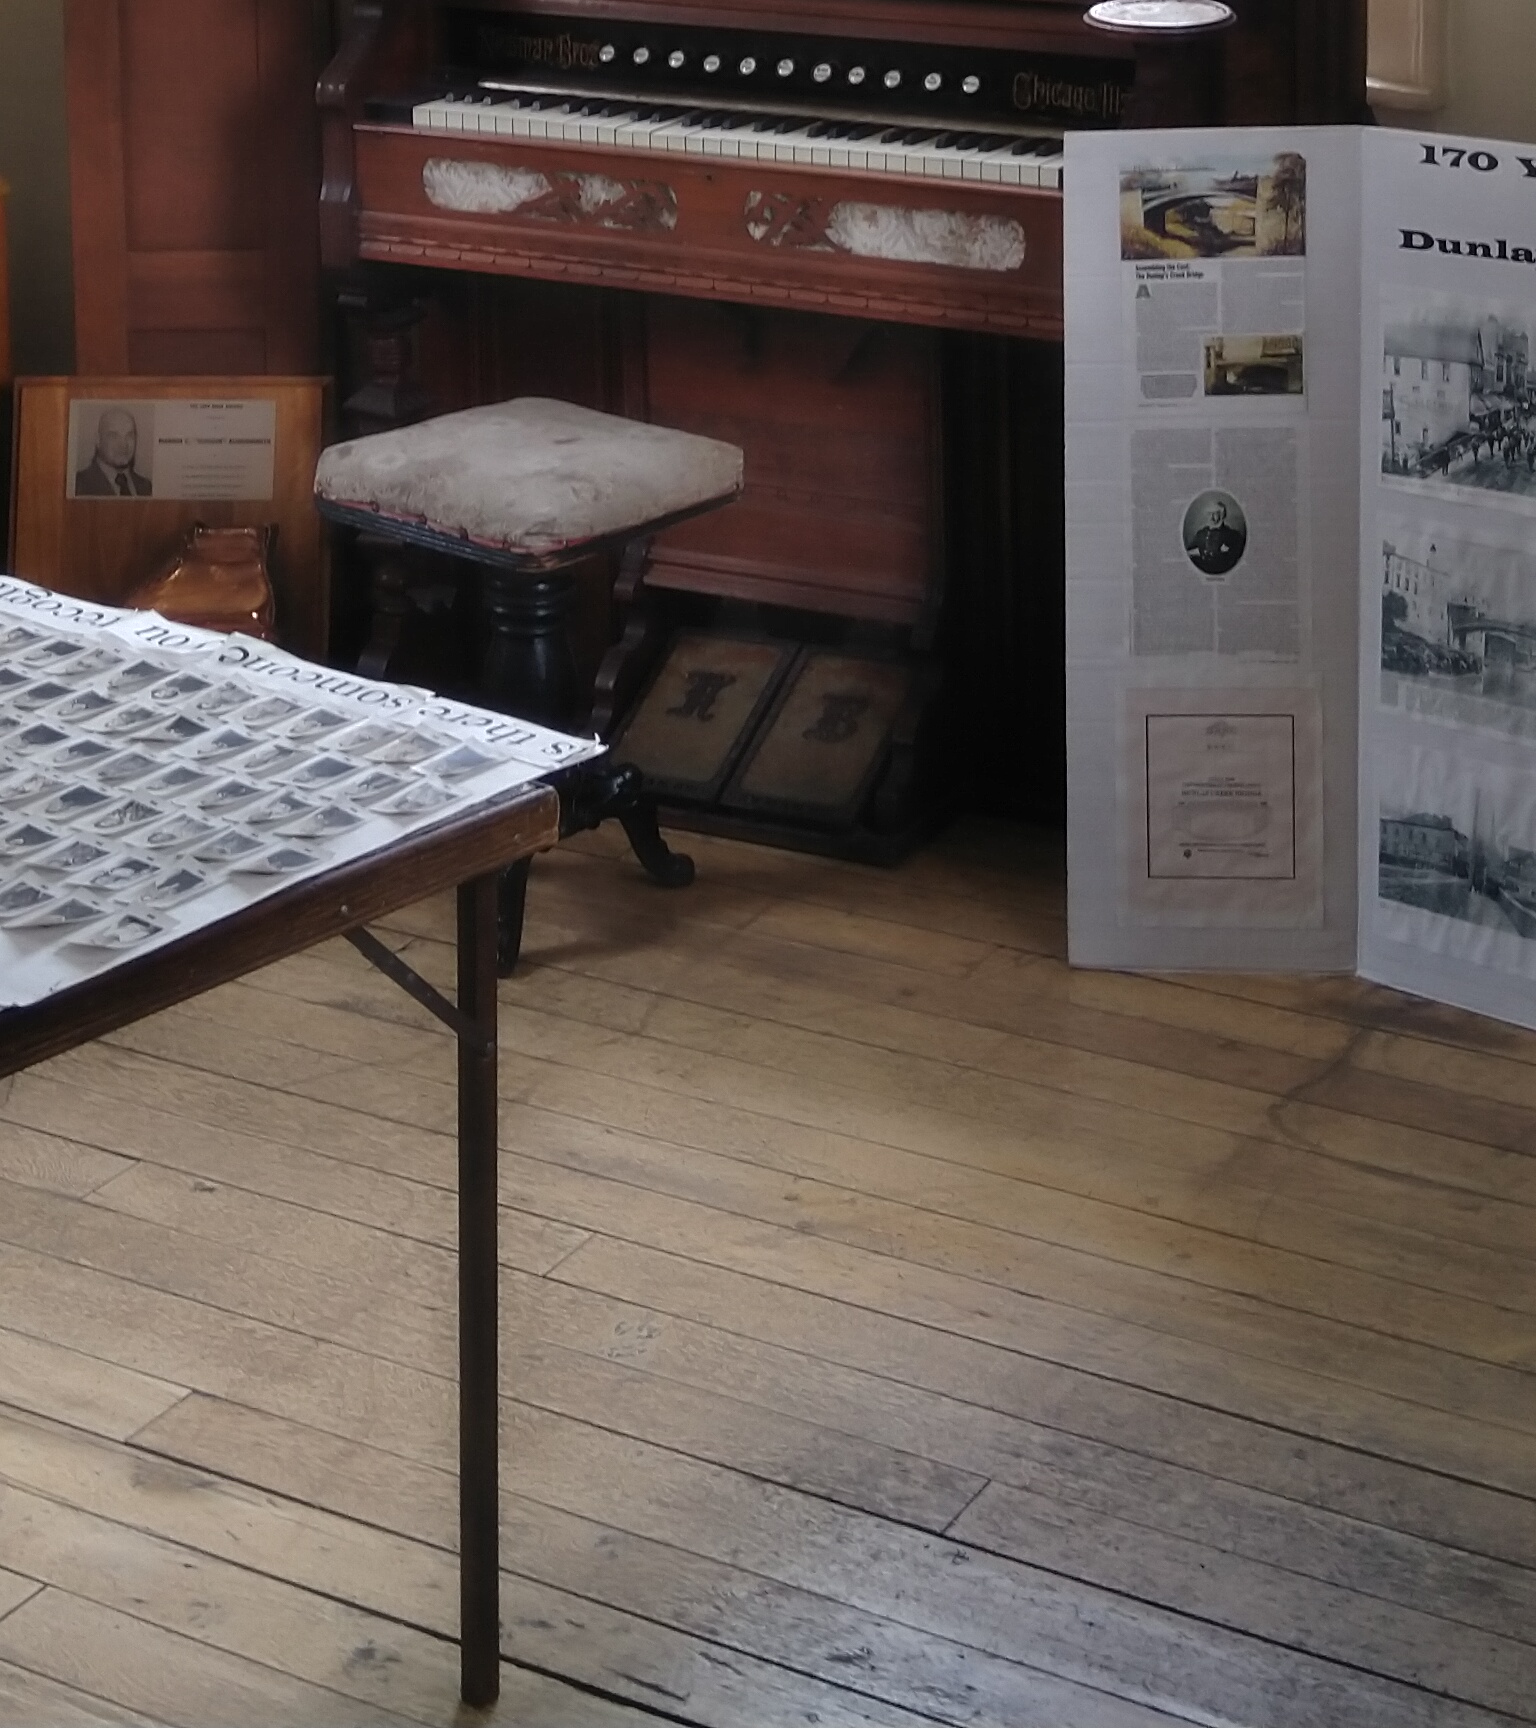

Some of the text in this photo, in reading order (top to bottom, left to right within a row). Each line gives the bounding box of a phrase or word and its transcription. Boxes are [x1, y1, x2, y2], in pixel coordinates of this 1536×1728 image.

[1419, 143, 1500, 173] 170
[217, 645, 413, 712] someone
[419, 705, 538, 746] there
